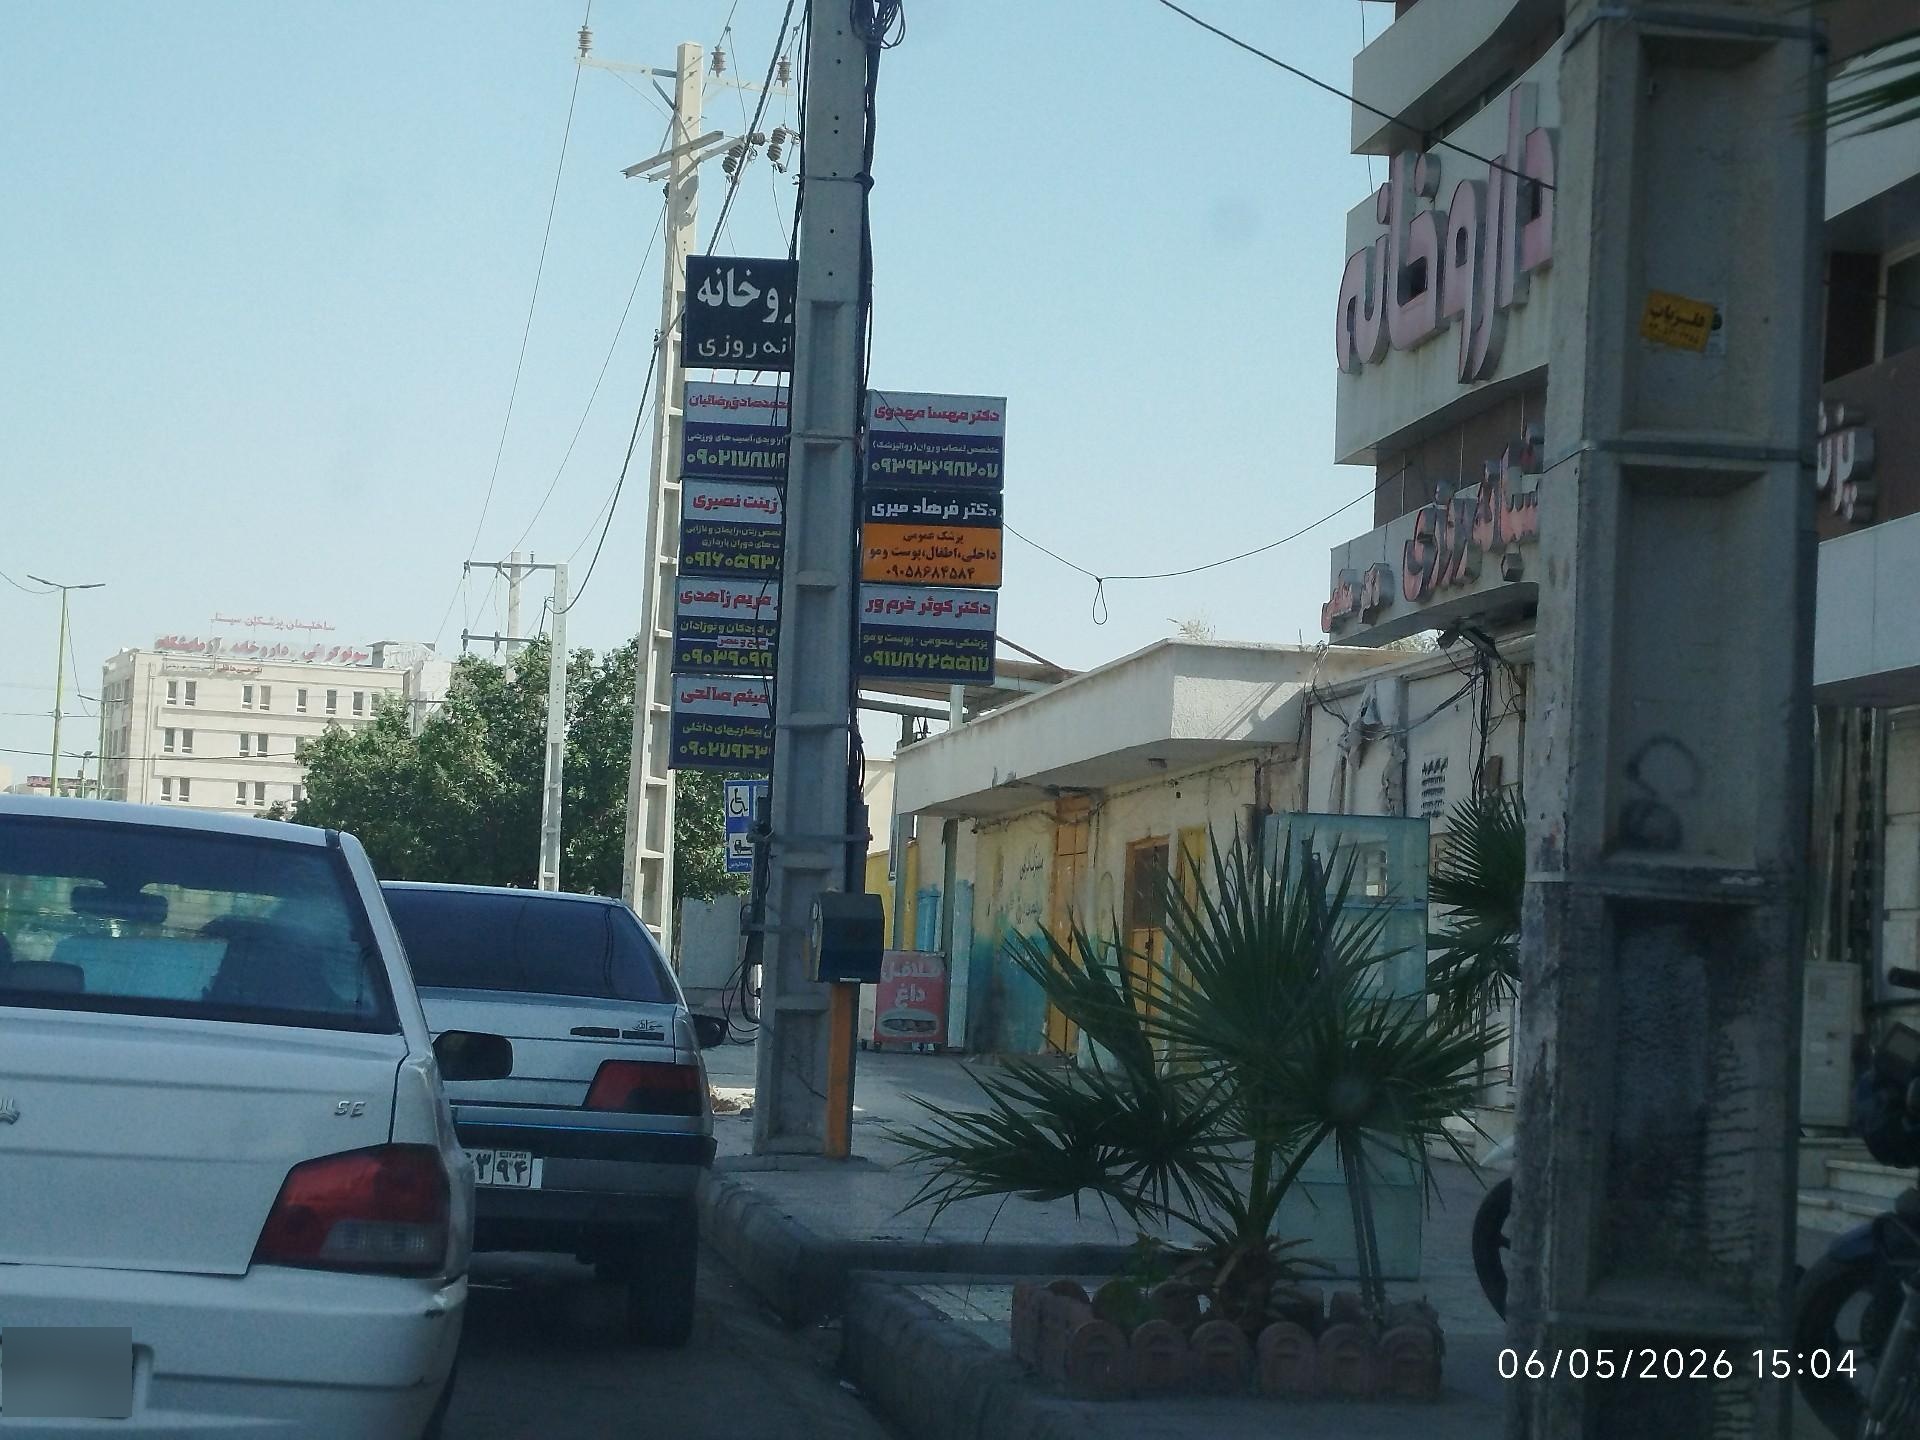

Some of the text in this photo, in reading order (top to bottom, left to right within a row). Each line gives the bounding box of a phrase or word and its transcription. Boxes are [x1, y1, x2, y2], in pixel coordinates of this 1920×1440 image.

[697, 266, 792, 324] وخانه
[698, 334, 757, 358] روزی
[873, 405, 1000, 425] دکتر مهسا مهدوی
[714, 433, 732, 442] های
[941, 444, 966, 454] اعصاب
[692, 494, 779, 515] زینت نصیری
[871, 497, 997, 520] دکتر فرهاد میری
[903, 531, 964, 544] پزشک عمومی
[680, 589, 772, 610] مریم زاهدی
[886, 595, 916, 615] خرم
[917, 595, 954, 617] کوثر
[954, 600, 992, 618] دکتر
[680, 620, 717, 633] نوزادان
[680, 686, 769, 707] میثم صالحی
[682, 721, 713, 734] داخلی
[334, 1100, 366, 1118] SE
[496, 1159, 528, 1183] ۹۴
